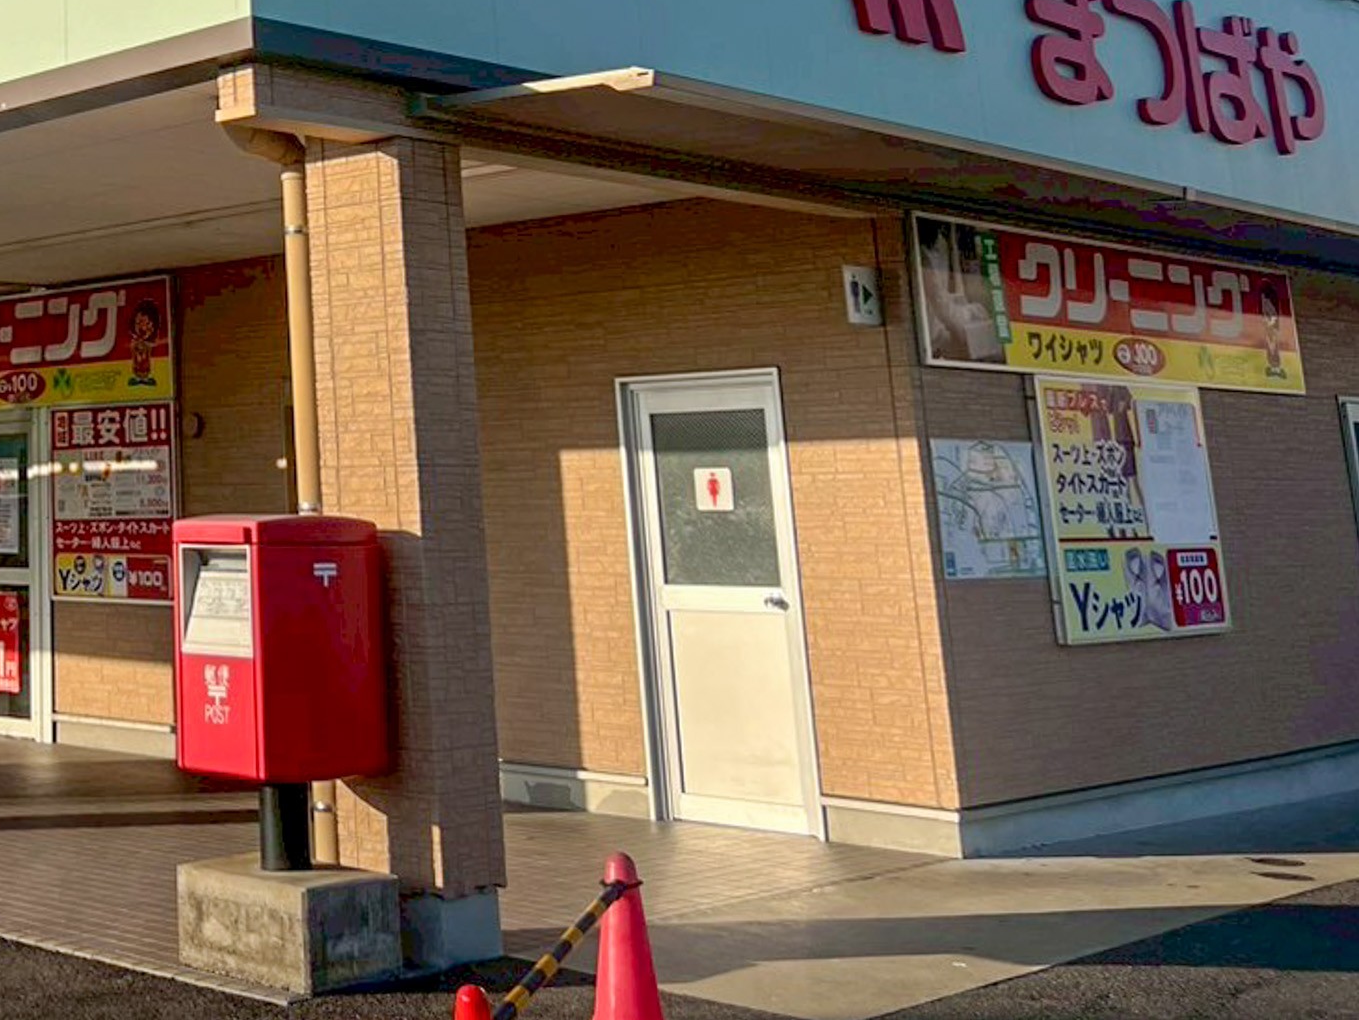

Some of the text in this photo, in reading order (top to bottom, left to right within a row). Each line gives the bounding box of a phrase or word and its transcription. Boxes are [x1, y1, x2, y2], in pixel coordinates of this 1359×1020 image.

[1018, 242, 1251, 339] クリーニング
[1027, 332, 1103, 365] ワイシャツ
[72, 406, 168, 446] 最安値!!
[1174, 568, 1218, 605] ¥100
[1069, 581, 1142, 631] Yシャツ
[204, 704, 231, 725] POST
